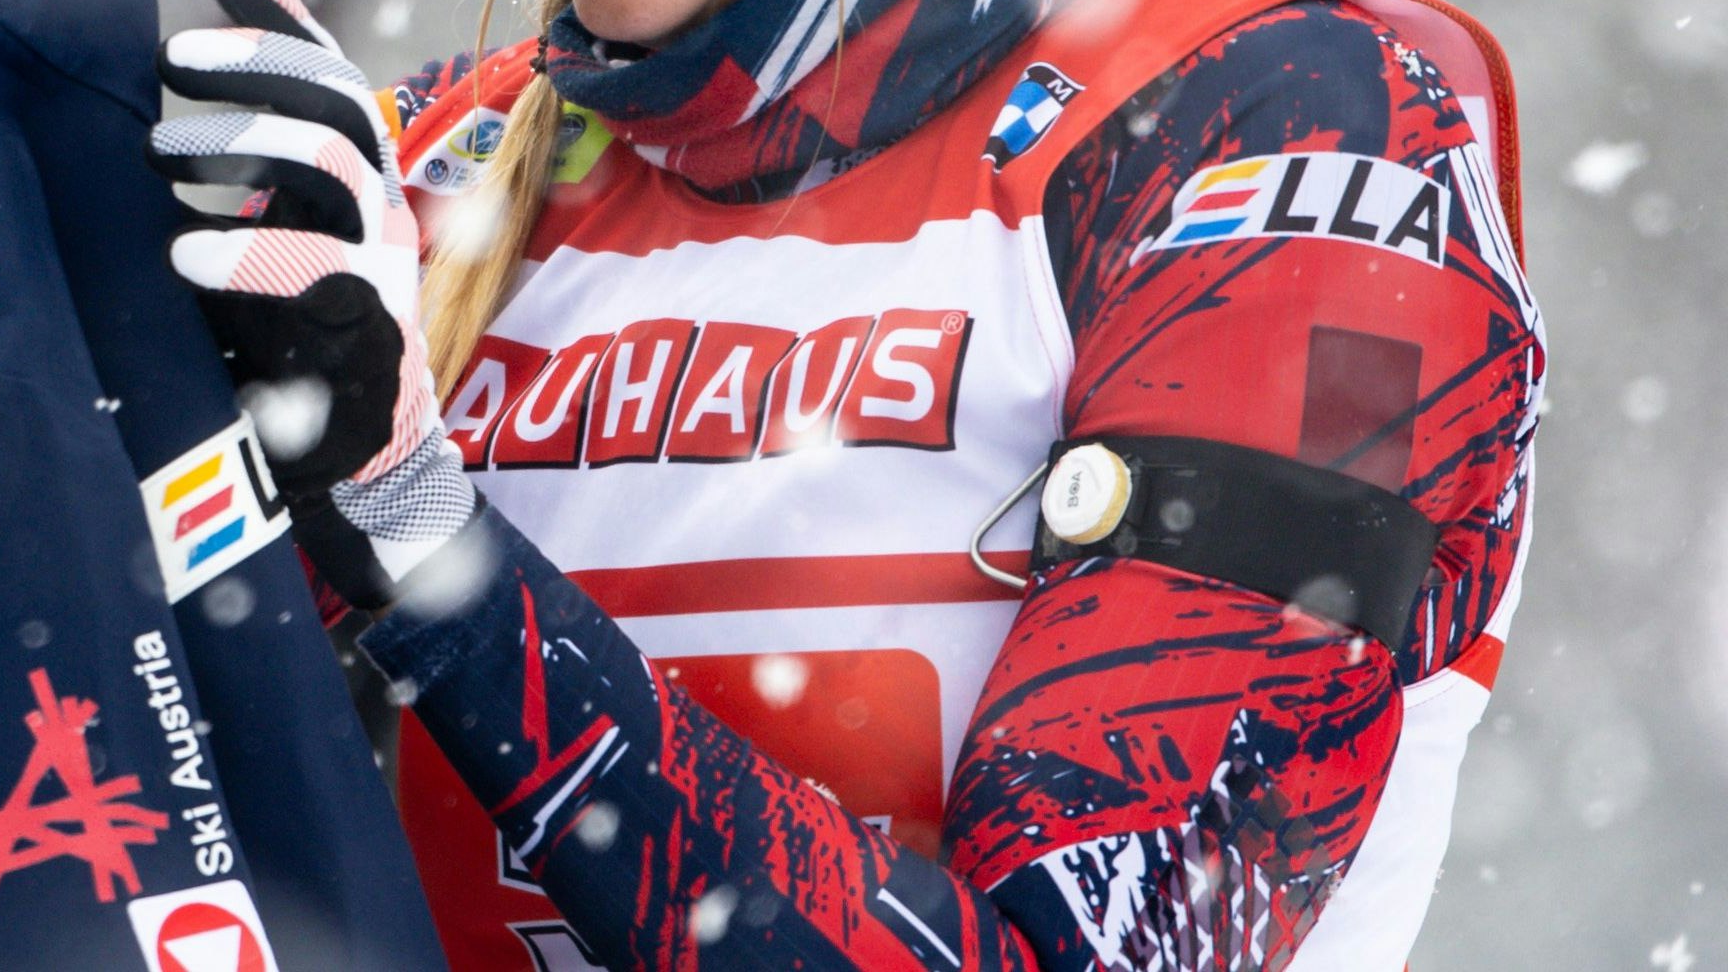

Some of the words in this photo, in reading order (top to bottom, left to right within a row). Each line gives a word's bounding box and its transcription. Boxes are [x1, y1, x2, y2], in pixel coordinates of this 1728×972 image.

[445, 326, 944, 444] AUHAUS
[133, 629, 213, 790] Austria
[181, 802, 234, 877] Ski
